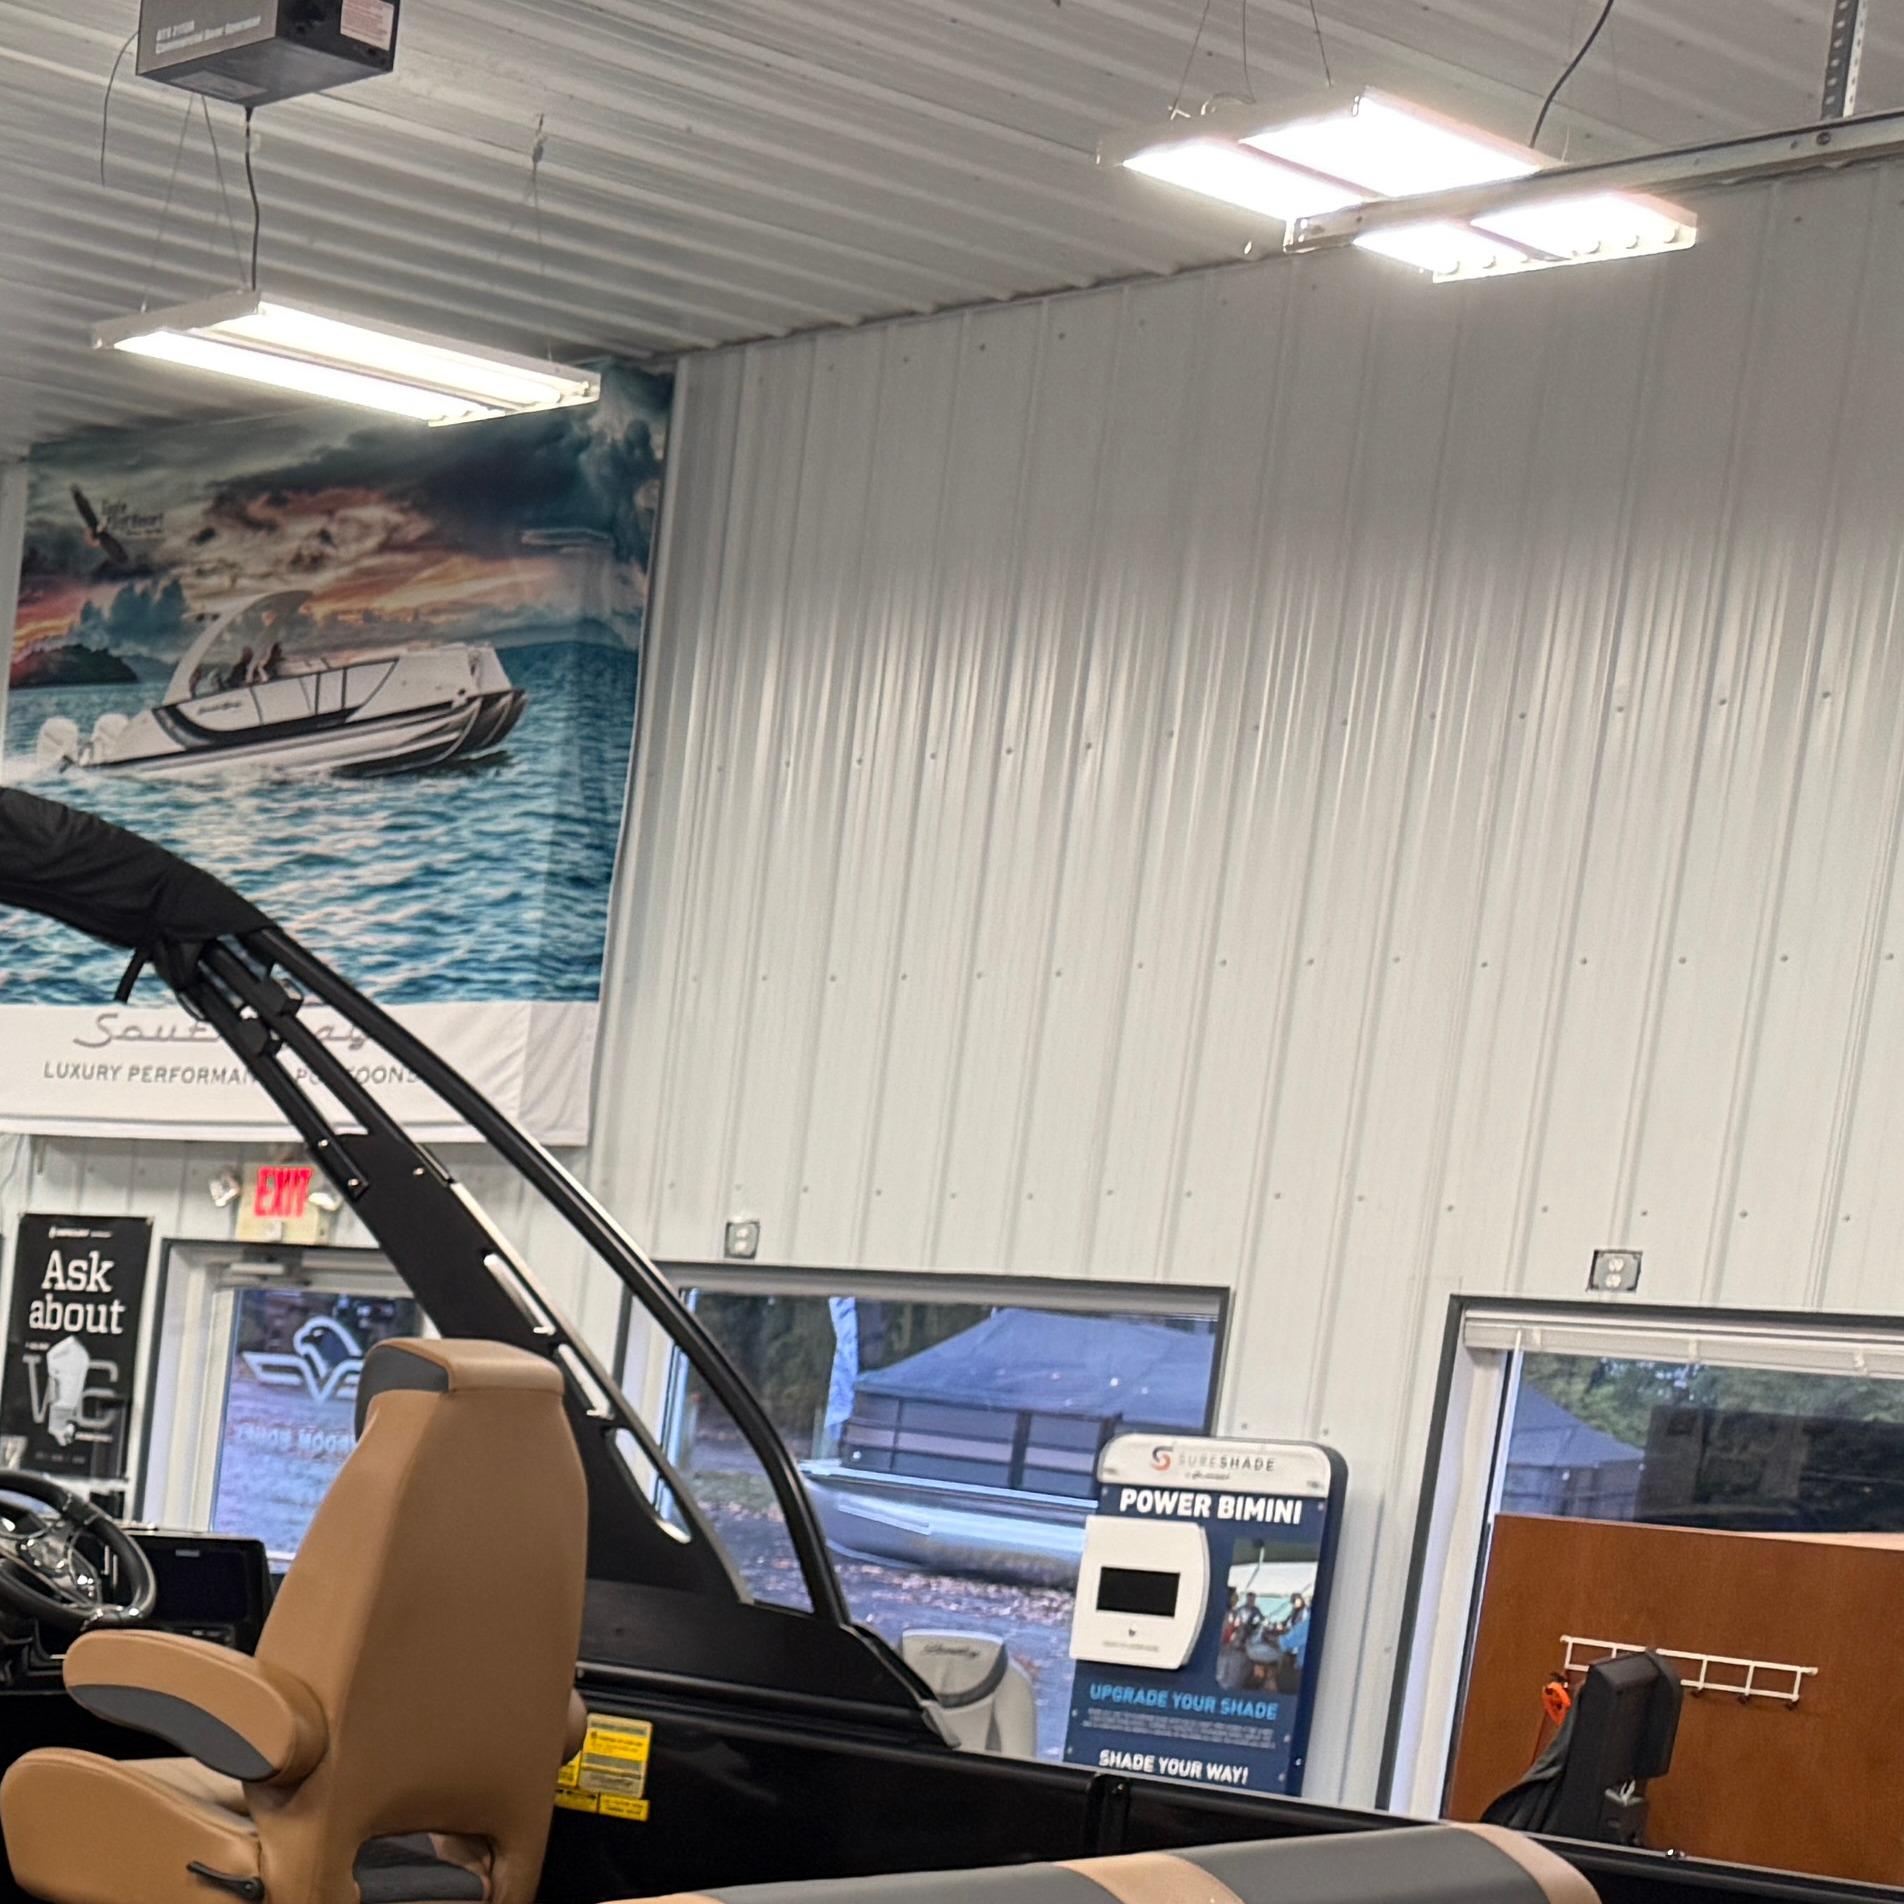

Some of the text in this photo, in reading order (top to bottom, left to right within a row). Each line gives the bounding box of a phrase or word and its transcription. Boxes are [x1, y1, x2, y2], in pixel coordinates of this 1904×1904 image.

[73, 1012, 220, 1049] Sout
[43, 1061, 123, 1081] LUXURY
[128, 1064, 257, 1086] PERFORMAN
[256, 1167, 314, 1217] EXIT
[41, 1249, 115, 1293] Ask
[28, 1293, 126, 1335] about
[1177, 1452, 1277, 1472] SURESHADE
[1119, 1488, 1303, 1525] POWER BIMINI
[1089, 1683, 1279, 1721] UPGRADE YOUR SHADE
[1099, 1749, 1249, 1784] SHADE YOUR WAY!
